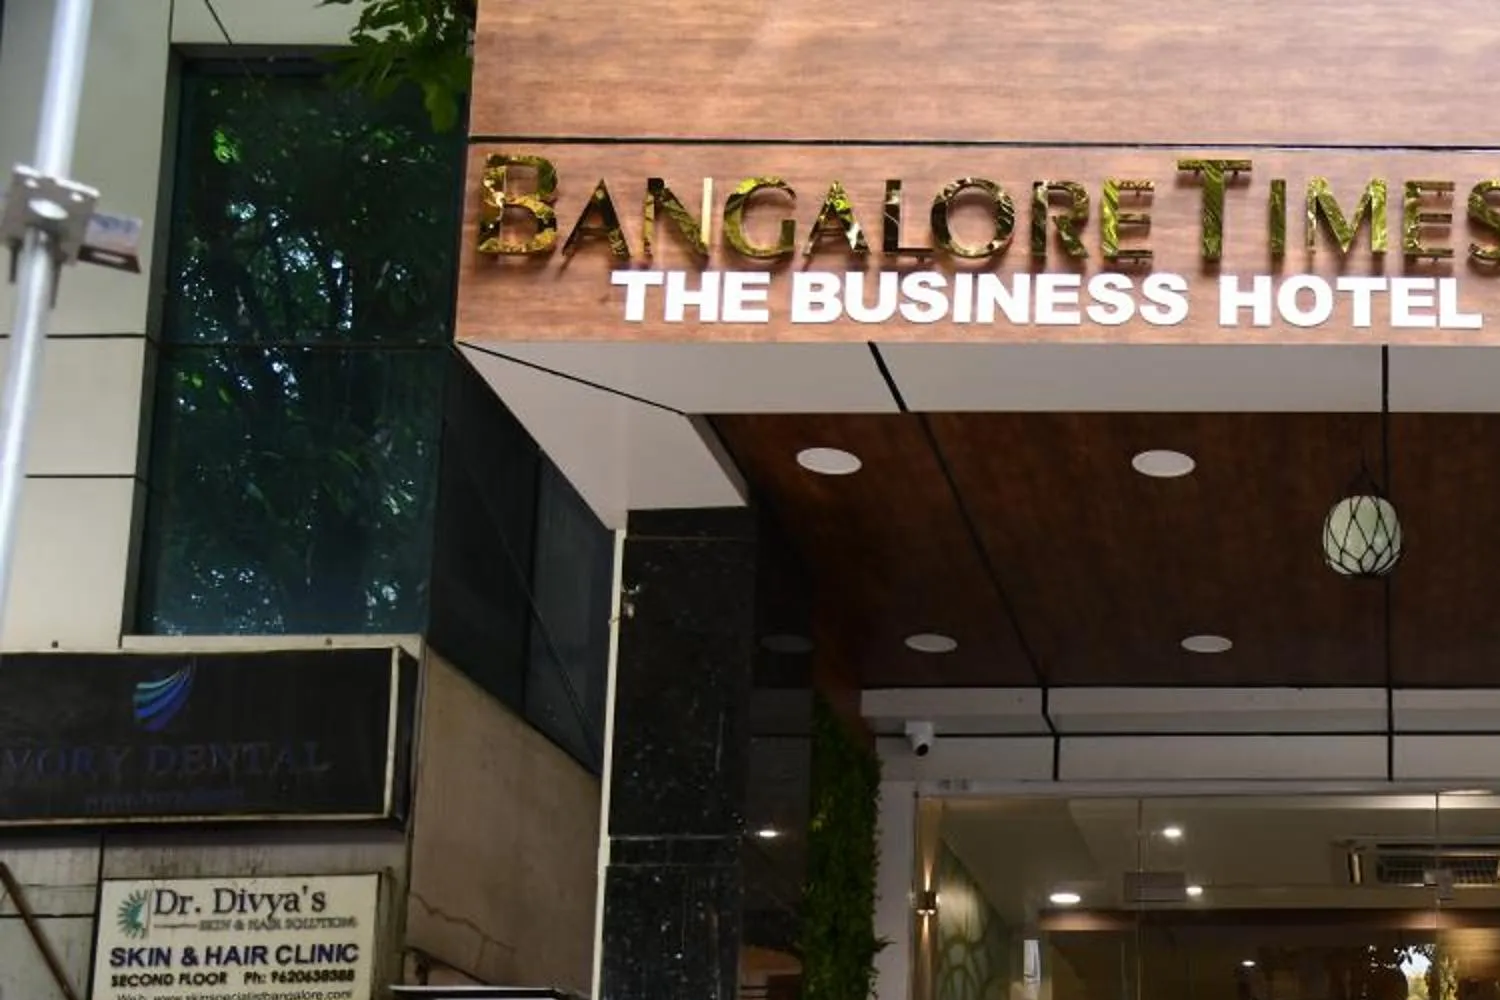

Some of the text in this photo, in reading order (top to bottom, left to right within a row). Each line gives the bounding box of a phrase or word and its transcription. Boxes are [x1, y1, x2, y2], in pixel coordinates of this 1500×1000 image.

[475, 152, 1155, 262] BANGALORE
[611, 271, 1484, 330] THE BUSINESS HOTEL
[153, 885, 328, 919] Dr. Divya's
[109, 943, 360, 968] SKIN & HAIR CLINIC
[110, 972, 175, 988] SECOND
[178, 971, 228, 986] FLOOR
[243, 970, 267, 985] Ph:
